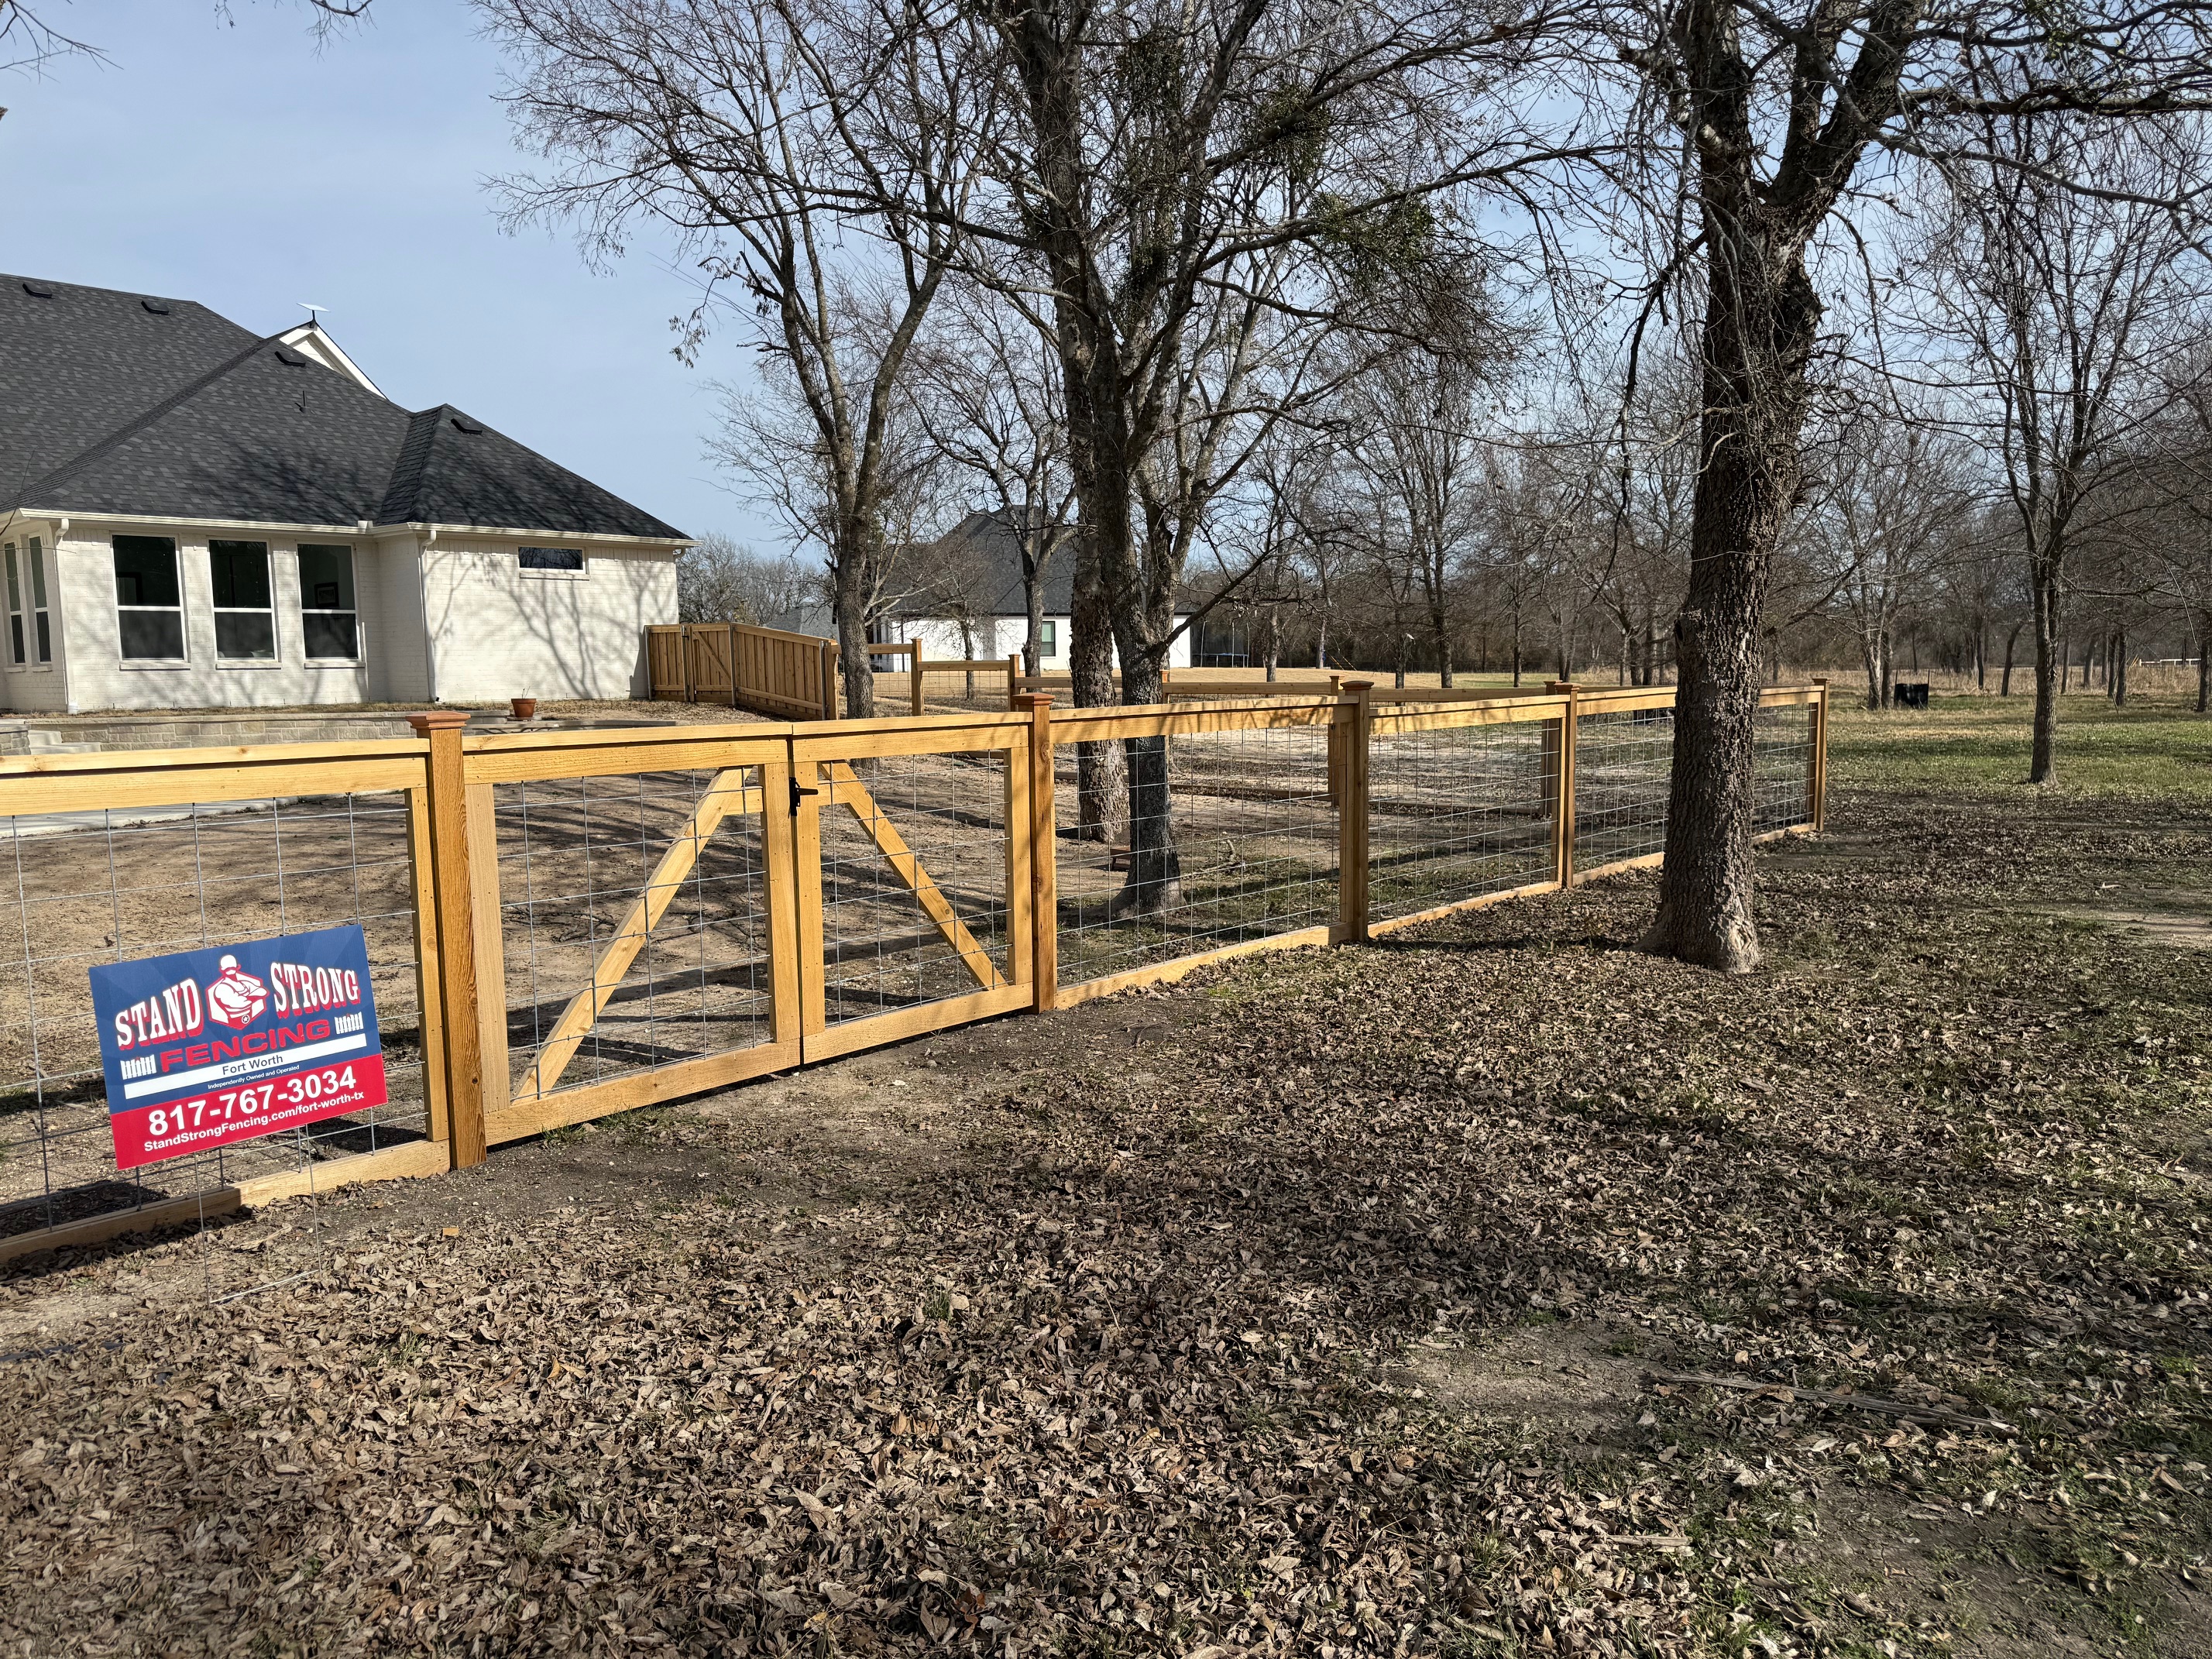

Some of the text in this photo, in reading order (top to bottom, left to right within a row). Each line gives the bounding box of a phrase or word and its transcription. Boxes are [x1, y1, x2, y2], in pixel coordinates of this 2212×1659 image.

[115, 961, 361, 1049] STAND STRONG
[160, 1019, 331, 1073] FENCING
[222, 1055, 283, 1075] Fort Worth
[149, 1066, 357, 1135] 817-767-3034
[208, 1077, 245, 1089] Independently
[246, 1072, 264, 1081] Owned
[276, 1065, 300, 1074] Operated
[143, 1091, 365, 1152] StandStrongFencing.com/fort-worth-tx
